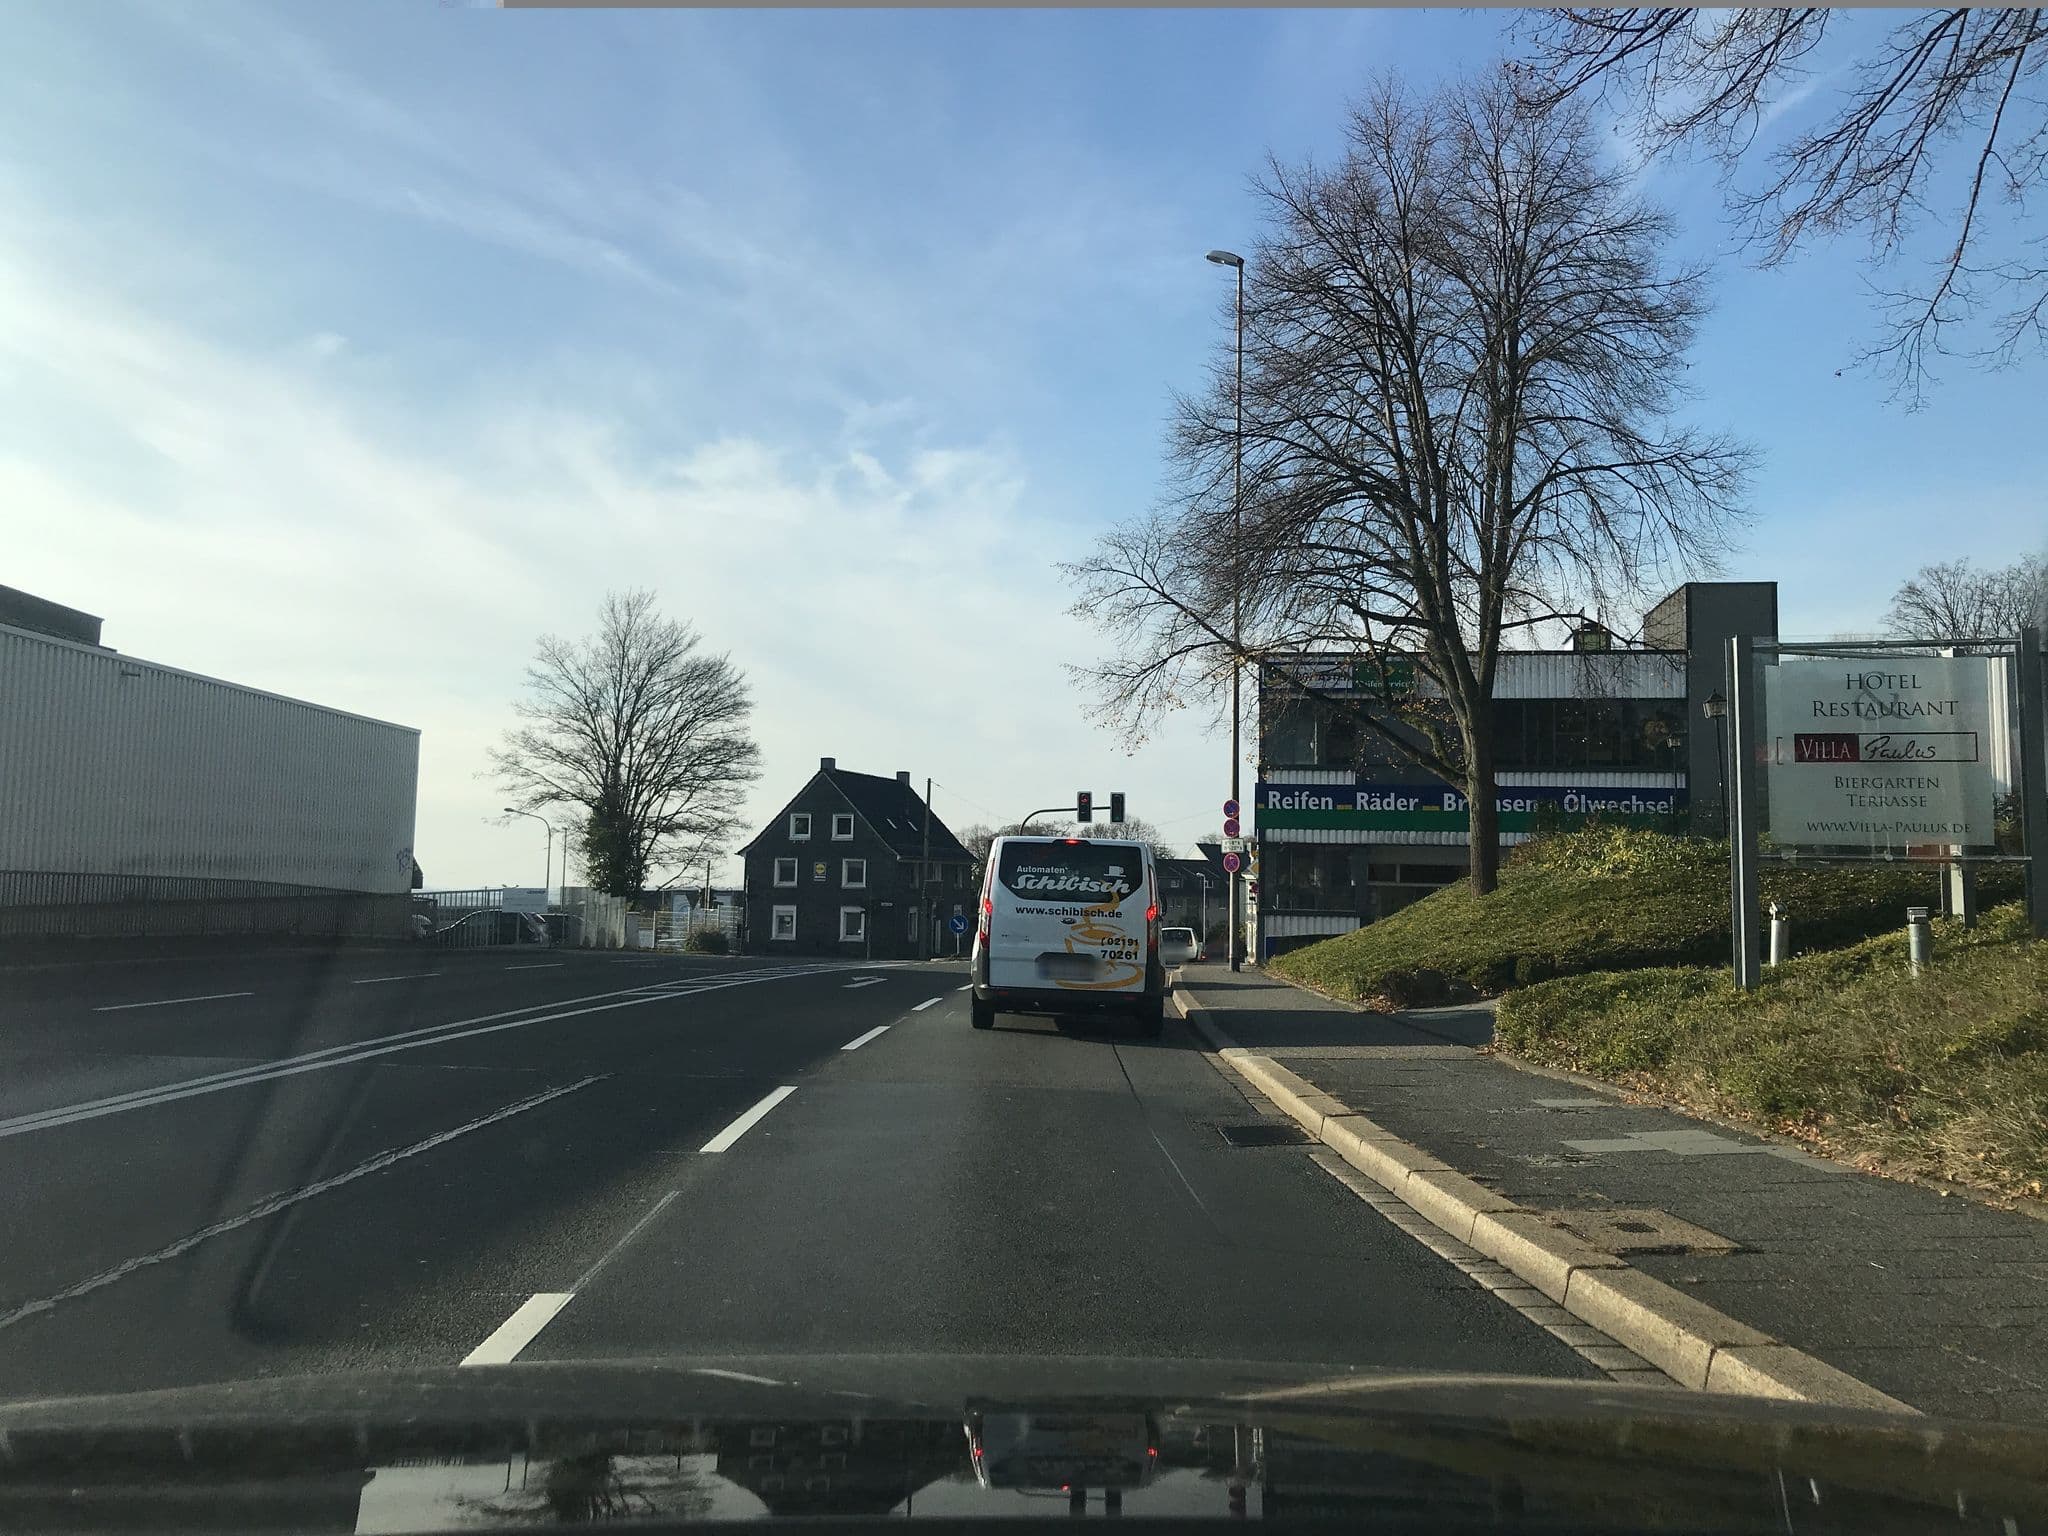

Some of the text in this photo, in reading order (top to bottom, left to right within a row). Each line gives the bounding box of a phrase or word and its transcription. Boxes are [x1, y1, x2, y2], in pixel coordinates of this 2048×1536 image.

[1845, 673, 1922, 690] HOTEL
[1812, 700, 1959, 717] RESTAURANT
[1800, 736, 1936, 760] VILLA Paulus
[1834, 776, 1939, 790] BIERGARTEN
[1267, 790, 1334, 811] Reifen
[1355, 791, 1420, 812] Räder
[1443, 792, 1538, 813] Brsen
[1845, 794, 1928, 808] TERRASSE
[1011, 874, 1131, 894] Schibisch
[1015, 906, 1123, 918] www.schibisch.de
[1101, 949, 1138, 960] 70261
